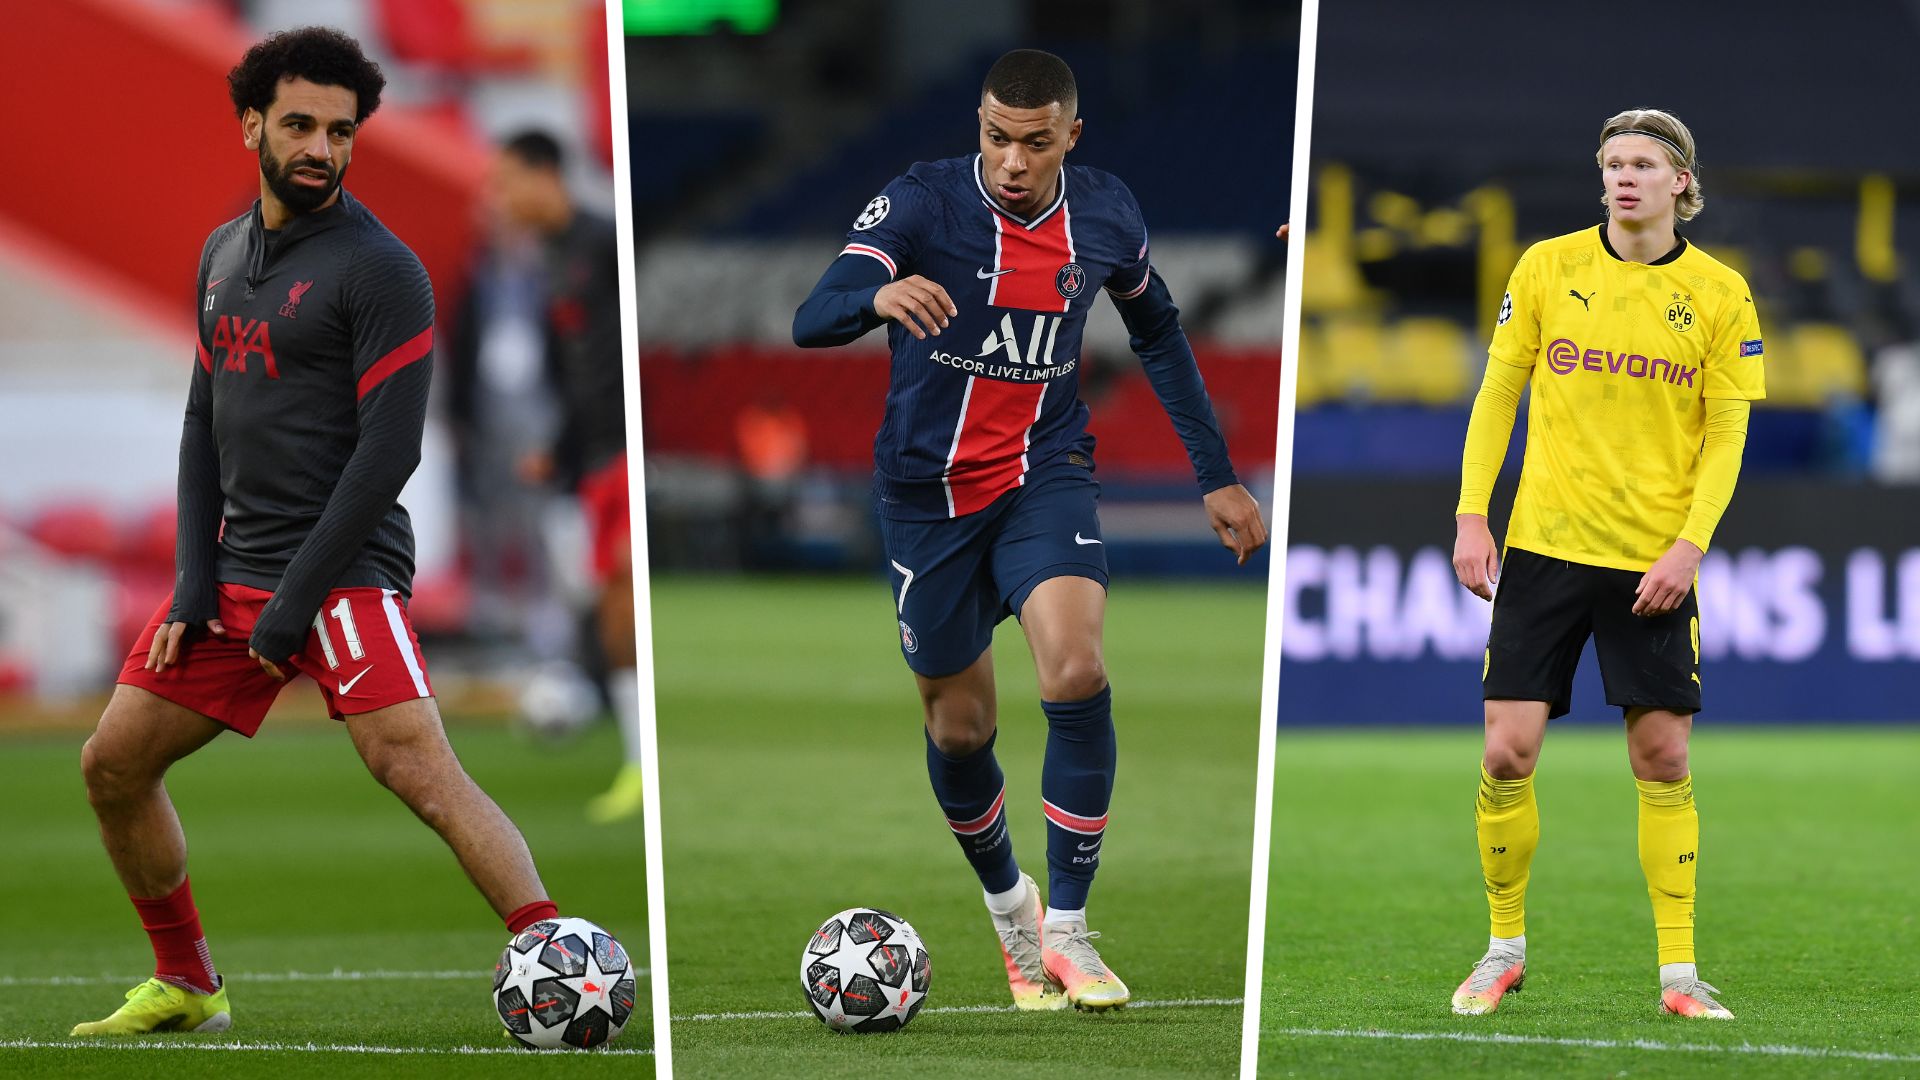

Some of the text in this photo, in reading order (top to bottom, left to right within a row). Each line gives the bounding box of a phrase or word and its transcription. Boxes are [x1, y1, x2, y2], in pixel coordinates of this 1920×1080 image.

[1062, 265, 1082, 276] PARIS
[205, 294, 215, 311] 11
[1668, 304, 1692, 325] BVB
[213, 314, 280, 379] AXA
[929, 350, 1076, 381] ACCOR LIVE LIMITLESS
[1582, 348, 1698, 389] EVONIK
[891, 559, 914, 615] 7
[312, 598, 366, 671] 11
